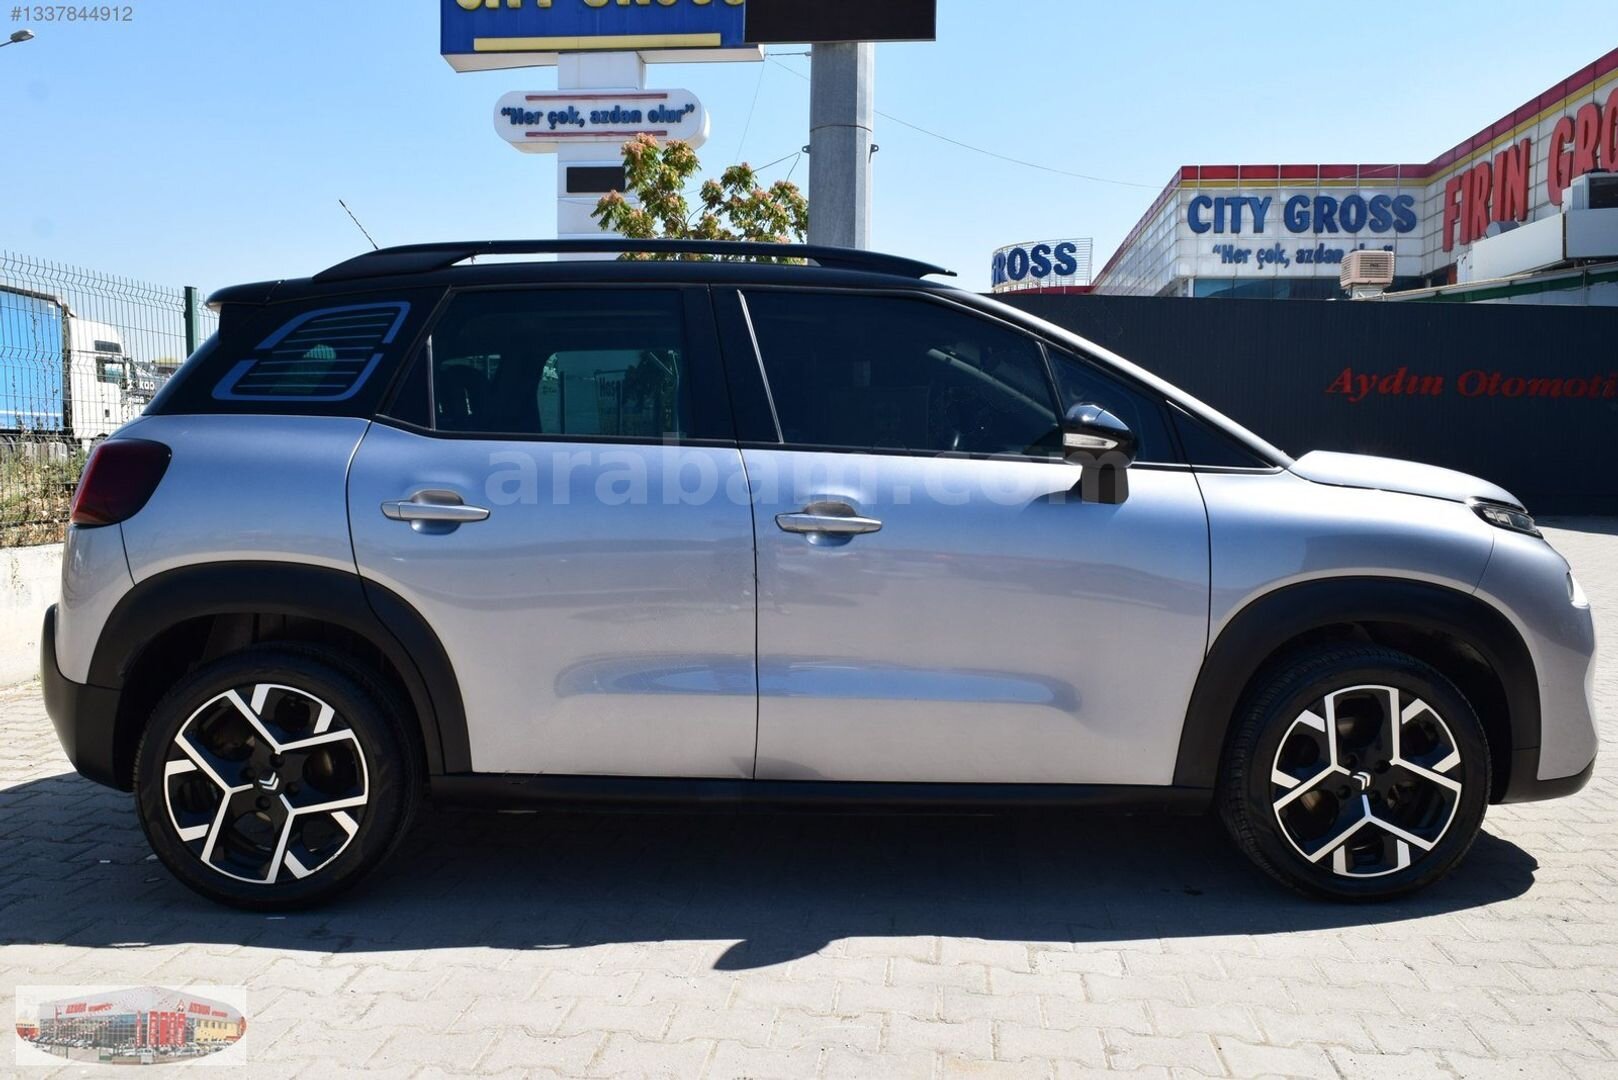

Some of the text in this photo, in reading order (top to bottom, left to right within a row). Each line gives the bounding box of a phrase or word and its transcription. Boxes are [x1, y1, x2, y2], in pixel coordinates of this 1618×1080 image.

[590, 105, 642, 124] azdan
[1442, 138, 1531, 252] FIRIN
[1187, 194, 1417, 234] CITY GROSS
[1295, 243, 1344, 264] azdan
[1325, 367, 1444, 402] Aydın
